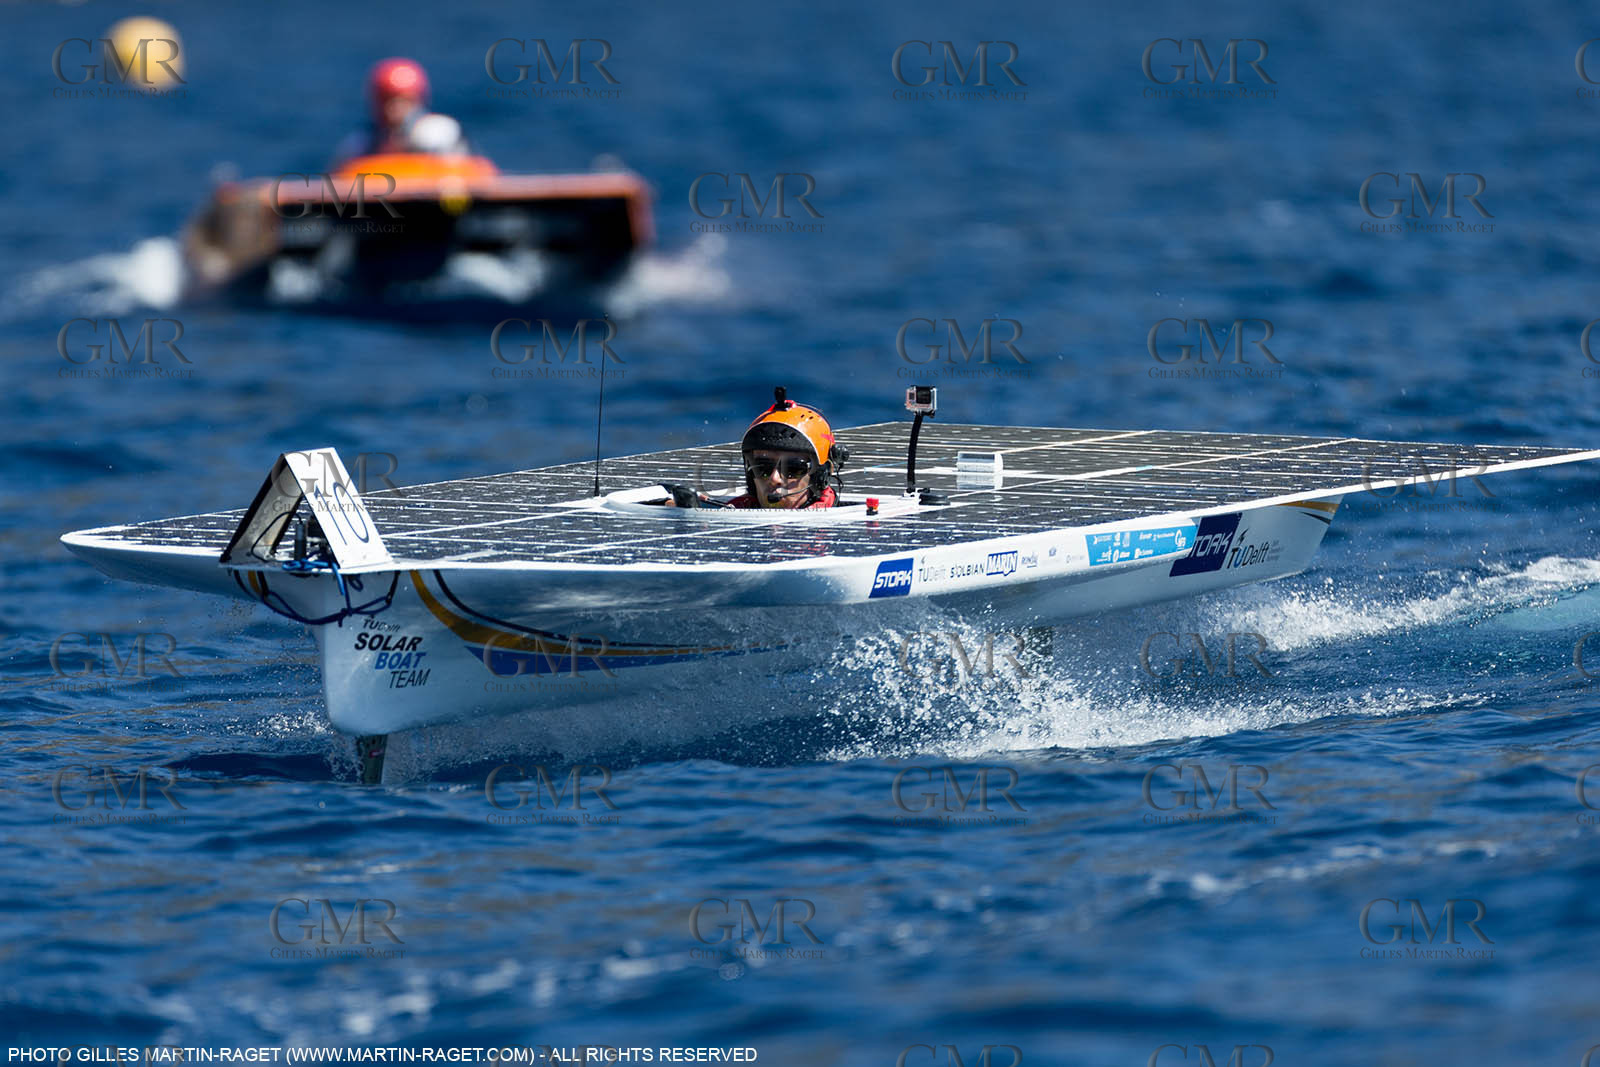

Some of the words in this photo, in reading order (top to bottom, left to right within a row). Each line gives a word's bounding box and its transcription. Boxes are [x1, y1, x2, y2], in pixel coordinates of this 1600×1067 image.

[313, 481, 369, 546] 10
[1190, 532, 1233, 558] TORK
[874, 570, 911, 588] STORK
[986, 551, 1018, 576] MARIN
[354, 632, 423, 651] SOLAR
[375, 651, 427, 670] BOAT
[389, 668, 431, 689] TEAM
